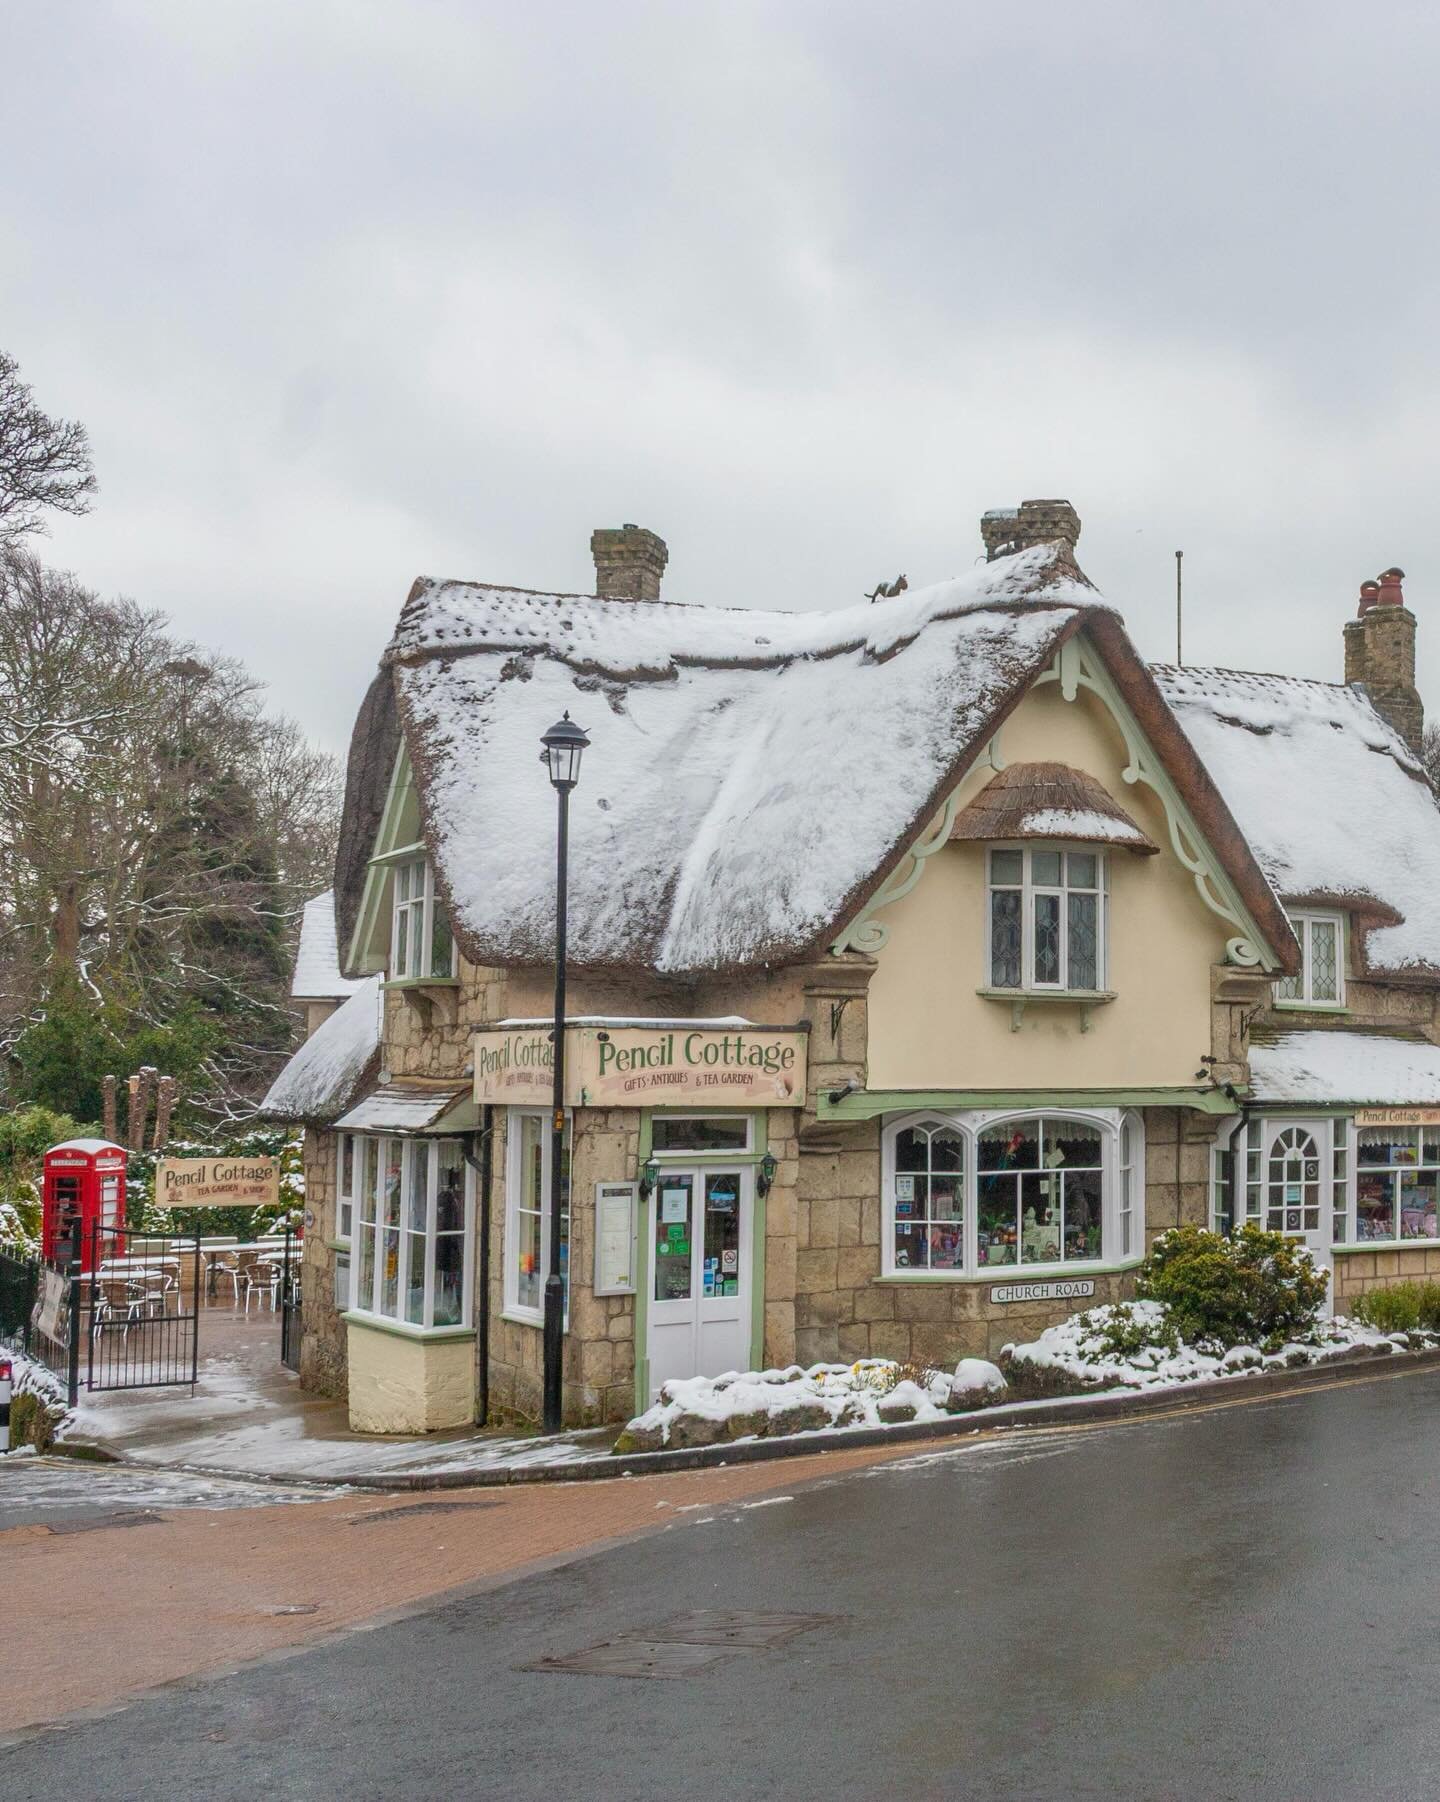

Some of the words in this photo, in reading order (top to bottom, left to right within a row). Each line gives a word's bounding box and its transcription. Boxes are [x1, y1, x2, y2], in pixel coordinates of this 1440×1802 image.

[480, 1036, 511, 1078] Pencil
[514, 1036, 555, 1073] Cottag
[599, 1034, 674, 1077] Pencil
[685, 1033, 795, 1075] Cottage
[624, 1076, 647, 1092] GIFTS
[651, 1072, 688, 1086] ANTIQUES
[695, 1076, 702, 1088] &
[704, 1073, 719, 1086] TEA
[721, 1073, 754, 1086] GARDEN
[1363, 1110, 1387, 1122] Pencil
[1389, 1110, 1421, 1123] Cottage
[165, 1165, 206, 1189] Pencil
[213, 1163, 273, 1183] Cottage
[198, 1186, 210, 1196] TEA
[212, 1183, 239, 1194] GARDEN
[997, 1285, 1049, 1301] CHURCH
[1055, 1282, 1090, 1297] ROAD
